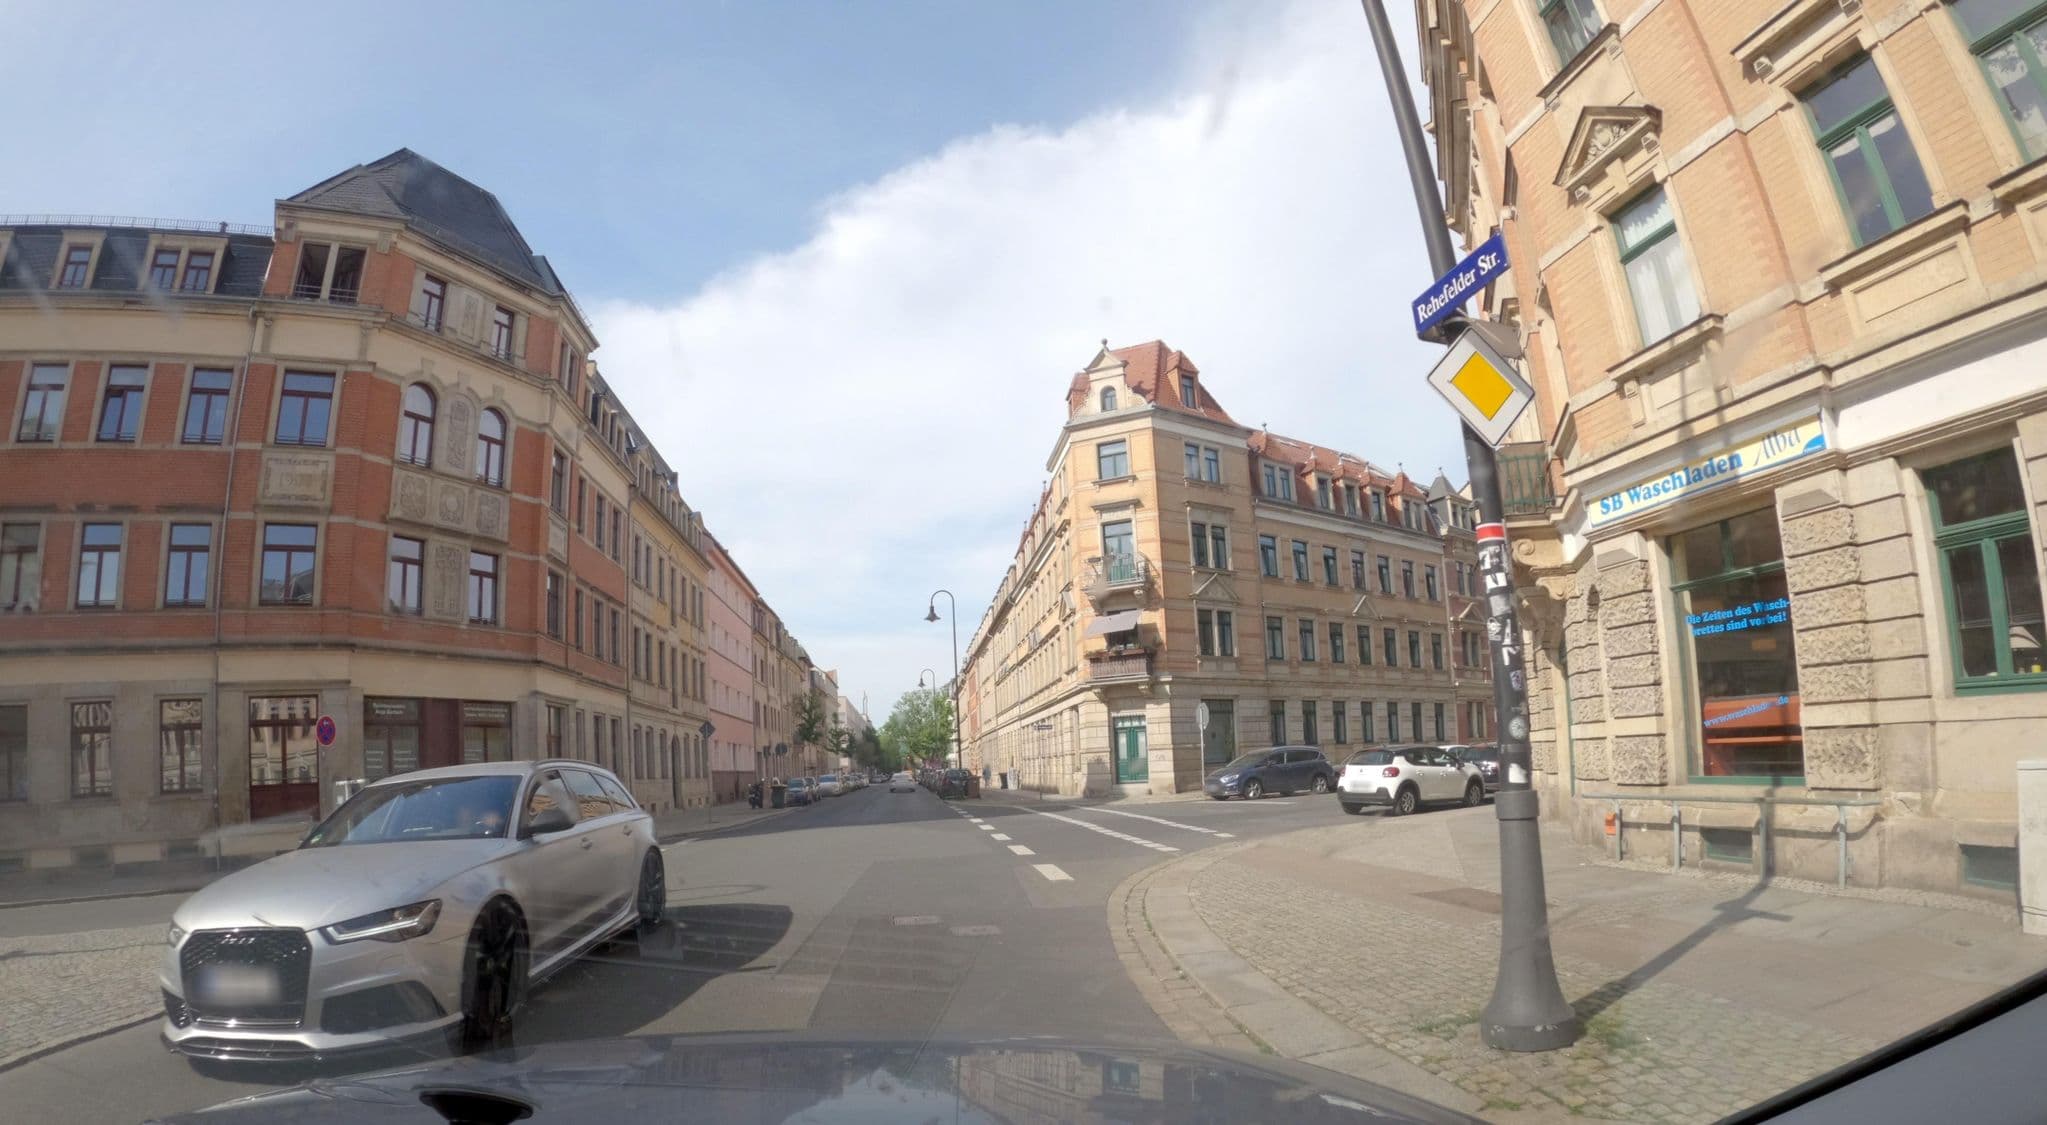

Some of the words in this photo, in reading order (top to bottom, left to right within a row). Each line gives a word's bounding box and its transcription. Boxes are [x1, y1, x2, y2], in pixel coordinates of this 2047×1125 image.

[1417, 268, 1477, 324] Rehefelder
[1477, 250, 1500, 276] Str.
[1599, 496, 1624, 515] SB
[1626, 452, 1743, 505] Waschladen
[1702, 609, 1733, 623] Zeiten
[1735, 606, 1752, 617] des
[1726, 618, 1748, 631] sind
